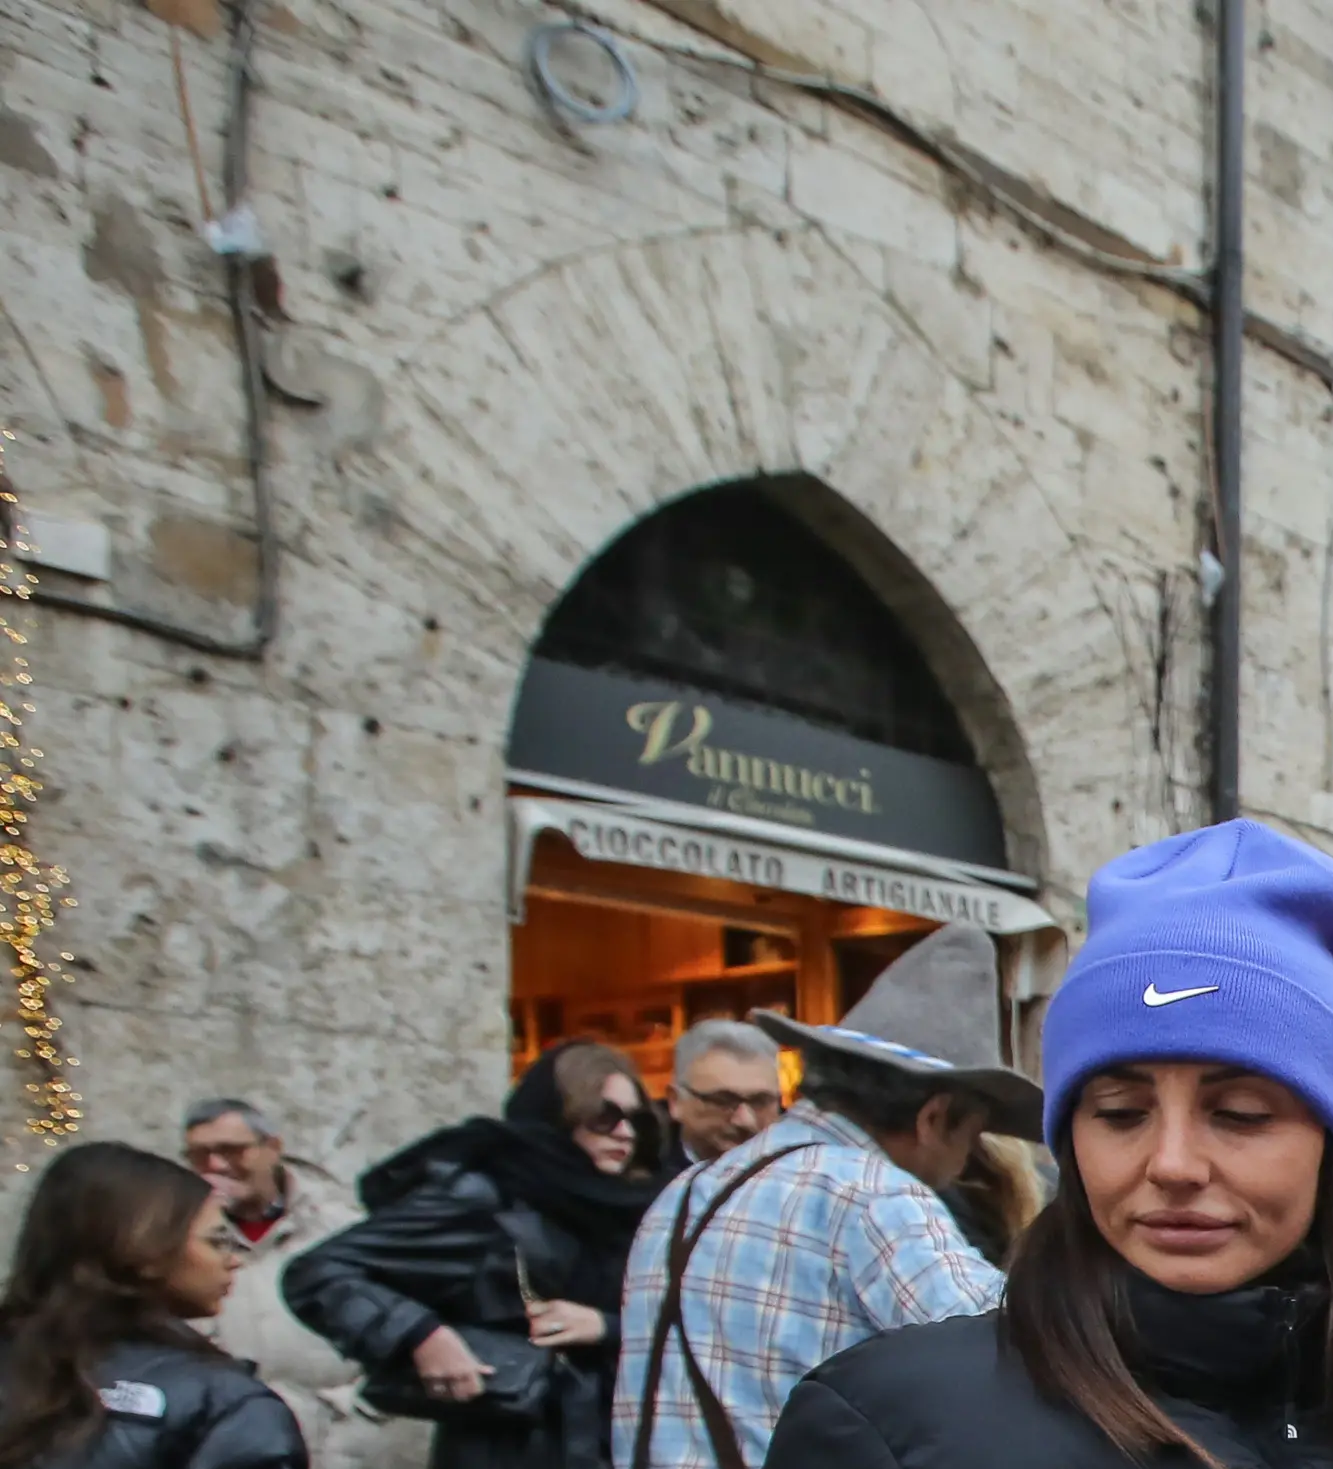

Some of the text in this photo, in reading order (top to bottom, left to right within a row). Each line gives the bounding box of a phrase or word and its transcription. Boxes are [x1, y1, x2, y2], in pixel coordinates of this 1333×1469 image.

[626, 700, 880, 814] Vannucci
[570, 818, 1000, 927] CIOCCOLATO ARTIGIANALE
